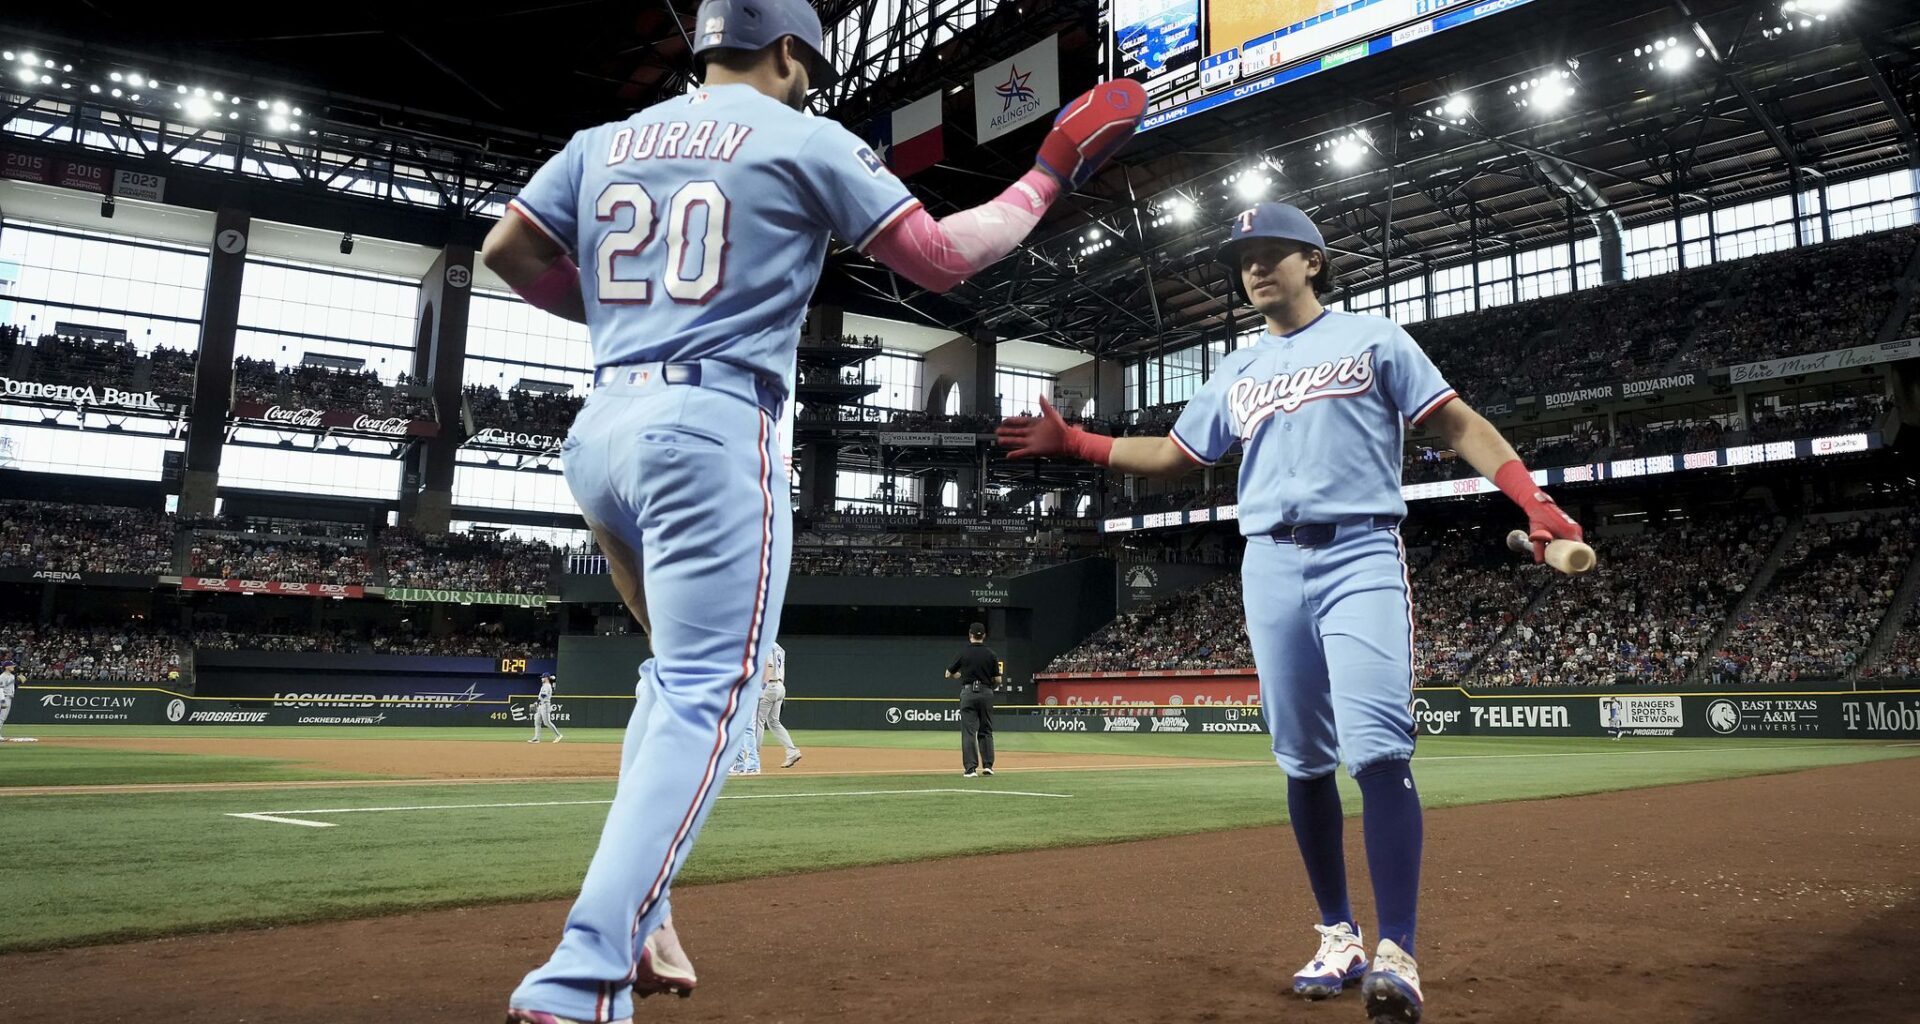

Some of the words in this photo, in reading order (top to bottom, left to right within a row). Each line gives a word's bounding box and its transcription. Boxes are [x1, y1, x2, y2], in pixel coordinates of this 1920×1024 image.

[1394, 29, 1415, 42] LAST
[1417, 24, 1430, 34] AB
[1233, 77, 1275, 97] CUTTER
[990, 98, 1041, 129] ARLINGTON
[606, 119, 753, 168] DURAN
[7, 152, 44, 169] 2015
[67, 163, 102, 179] 2016
[121, 172, 158, 188] 2023
[1237, 208, 1258, 233] T
[226, 234, 238, 248] 7
[595, 180, 731, 305] 20
[449, 269, 468, 284] 29
[1733, 363, 1775, 382] Blue
[1777, 353, 1831, 373] Mint
[1835, 348, 1877, 368] Thai
[1227, 349, 1375, 432] Rangers
[1544, 385, 1613, 406] BODYARMOR
[1622, 374, 1696, 395] BODYARMOR
[102, 387, 162, 409] Bank
[263, 405, 323, 428] Coca-Cola
[352, 414, 412, 436] Coca-Cola
[489, 428, 564, 449] CHOCTA
[1452, 479, 1480, 494] SCORE!
[32, 570, 82, 580] ARENA
[197, 578, 228, 587] DEX
[238, 579, 270, 589] DEX
[279, 581, 308, 591] DEX
[319, 583, 348, 593] DEX
[970, 589, 1009, 597] TEREMANA
[402, 588, 465, 604] LUXOR
[467, 590, 544, 607] STAFFING
[501, 658, 526, 673] 0:29
[49, 693, 136, 708] CHOCTAW
[273, 692, 377, 708] LOCKHEED
[379, 693, 456, 709] MARTIN
[1630, 700, 1675, 708] RANGERS
[1741, 700, 1772, 711] EAST
[1777, 700, 1818, 711] TEXAS
[188, 711, 267, 722] PROGRESSIVE
[490, 712, 508, 720] 410
[529, 713, 571, 721] TSFER
[904, 709, 943, 722] Globe
[1240, 708, 1259, 717] 374
[1631, 708, 1667, 716] SPORTS
[1631, 715, 1680, 723] NETWORK
[1762, 711, 1797, 723] A&M
[1865, 700, 1920, 732] Mobi
[298, 716, 341, 724] LOCKHEED
[341, 716, 374, 724] MARTIN
[1043, 716, 1087, 731] Kubota
[1201, 723, 1263, 732] HONDA
